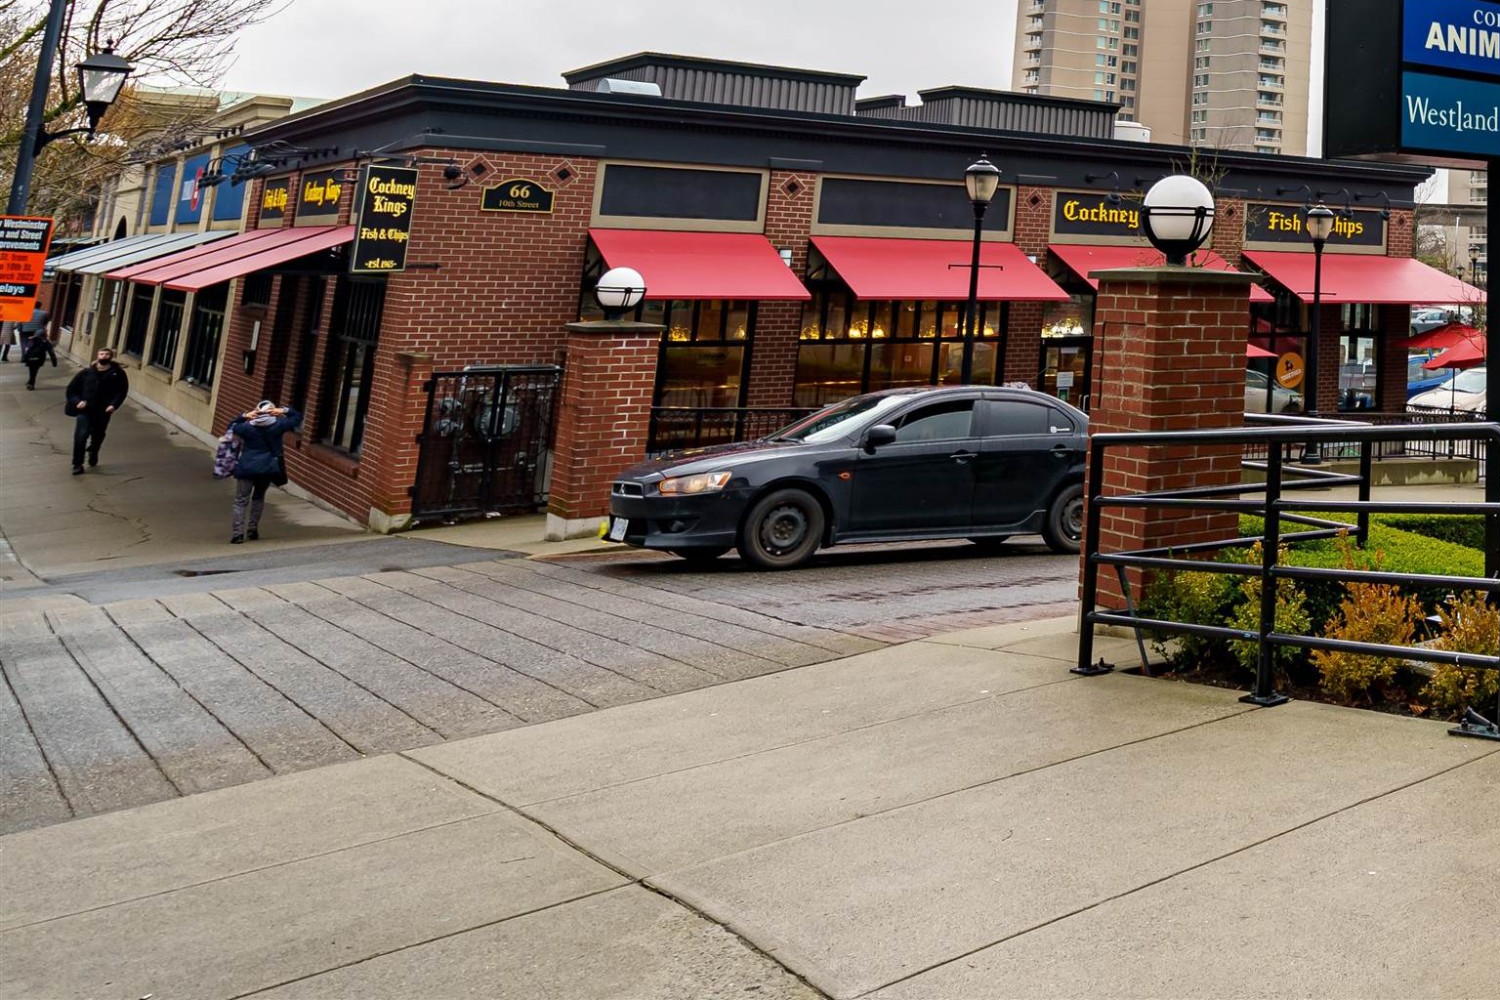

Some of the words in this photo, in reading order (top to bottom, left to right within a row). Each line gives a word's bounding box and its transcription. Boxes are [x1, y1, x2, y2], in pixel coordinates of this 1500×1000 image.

[1406, 95, 1499, 132] Westland
[369, 177, 415, 199] Cockney
[510, 184, 531, 198] 66
[373, 195, 407, 217] Kings
[517, 201, 539, 209] Street
[1063, 200, 1139, 229] Cockney
[1267, 211, 1301, 235] Fish
[1331, 215, 1364, 239] hips
